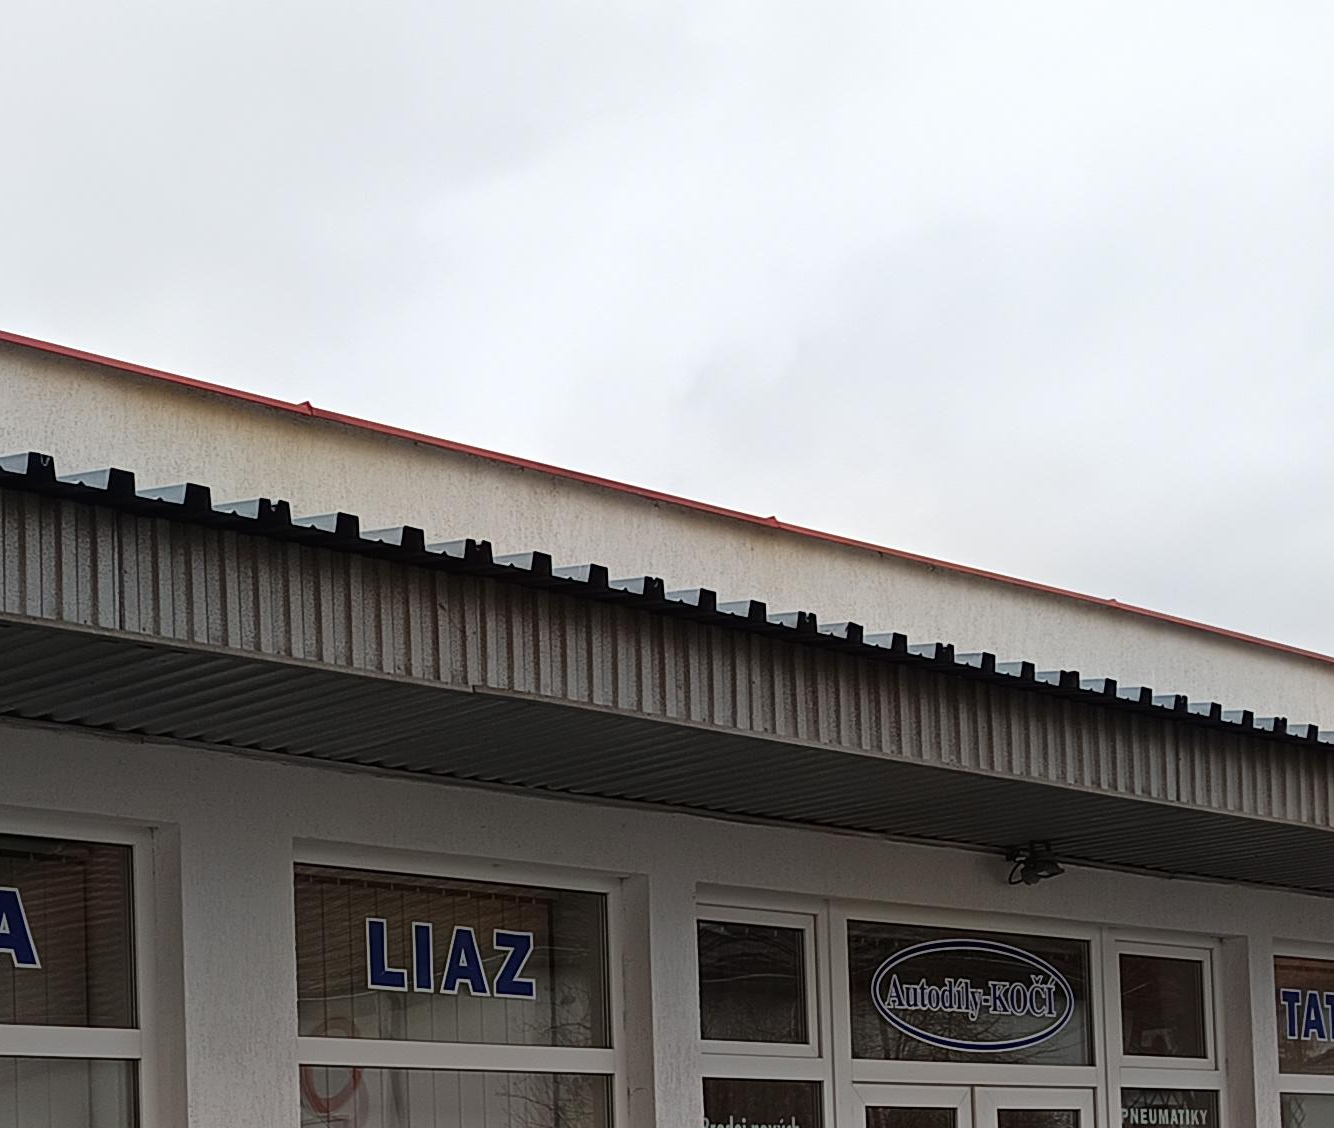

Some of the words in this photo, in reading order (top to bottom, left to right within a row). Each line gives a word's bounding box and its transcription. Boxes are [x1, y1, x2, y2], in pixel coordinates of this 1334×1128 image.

[365, 917, 536, 999] LIAZ
[885, 974, 1057, 1021] Autodíly-KOČÍ
[1122, 1108, 1207, 1125] PNEUMATIKY
